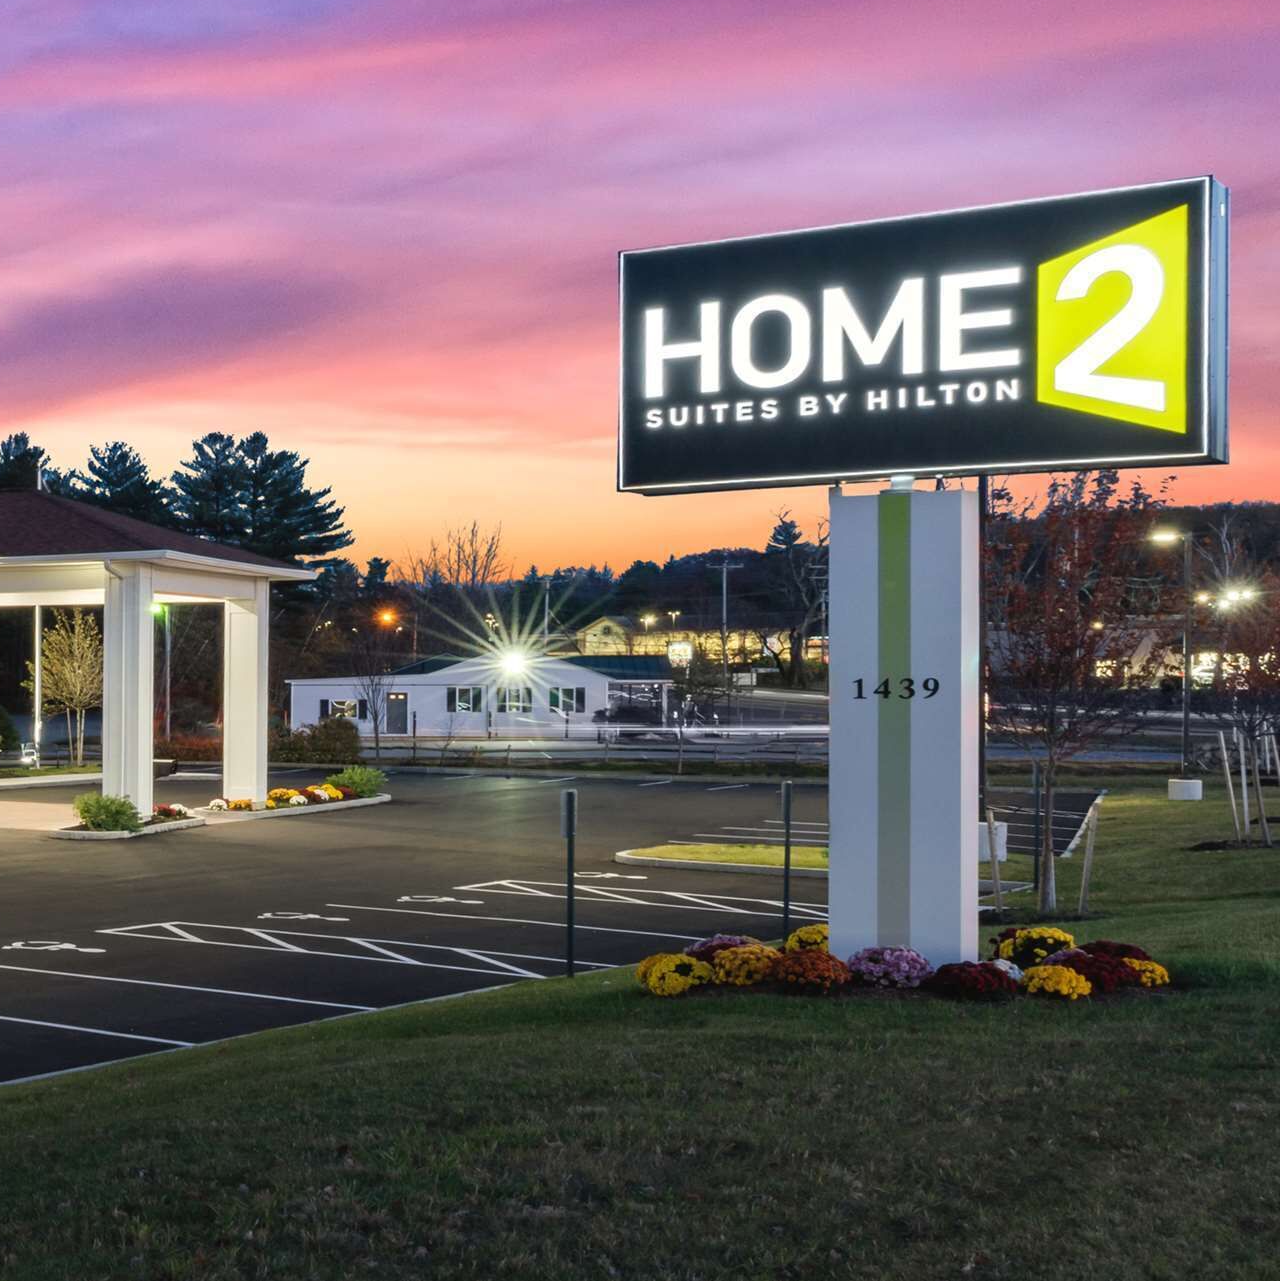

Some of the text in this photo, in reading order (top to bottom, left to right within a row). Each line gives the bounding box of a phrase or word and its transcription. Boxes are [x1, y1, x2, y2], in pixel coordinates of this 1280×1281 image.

[644, 244, 1166, 412] HOME 2
[646, 378, 1020, 429] SUITES BY HILTON
[852, 677, 940, 700] 1439
